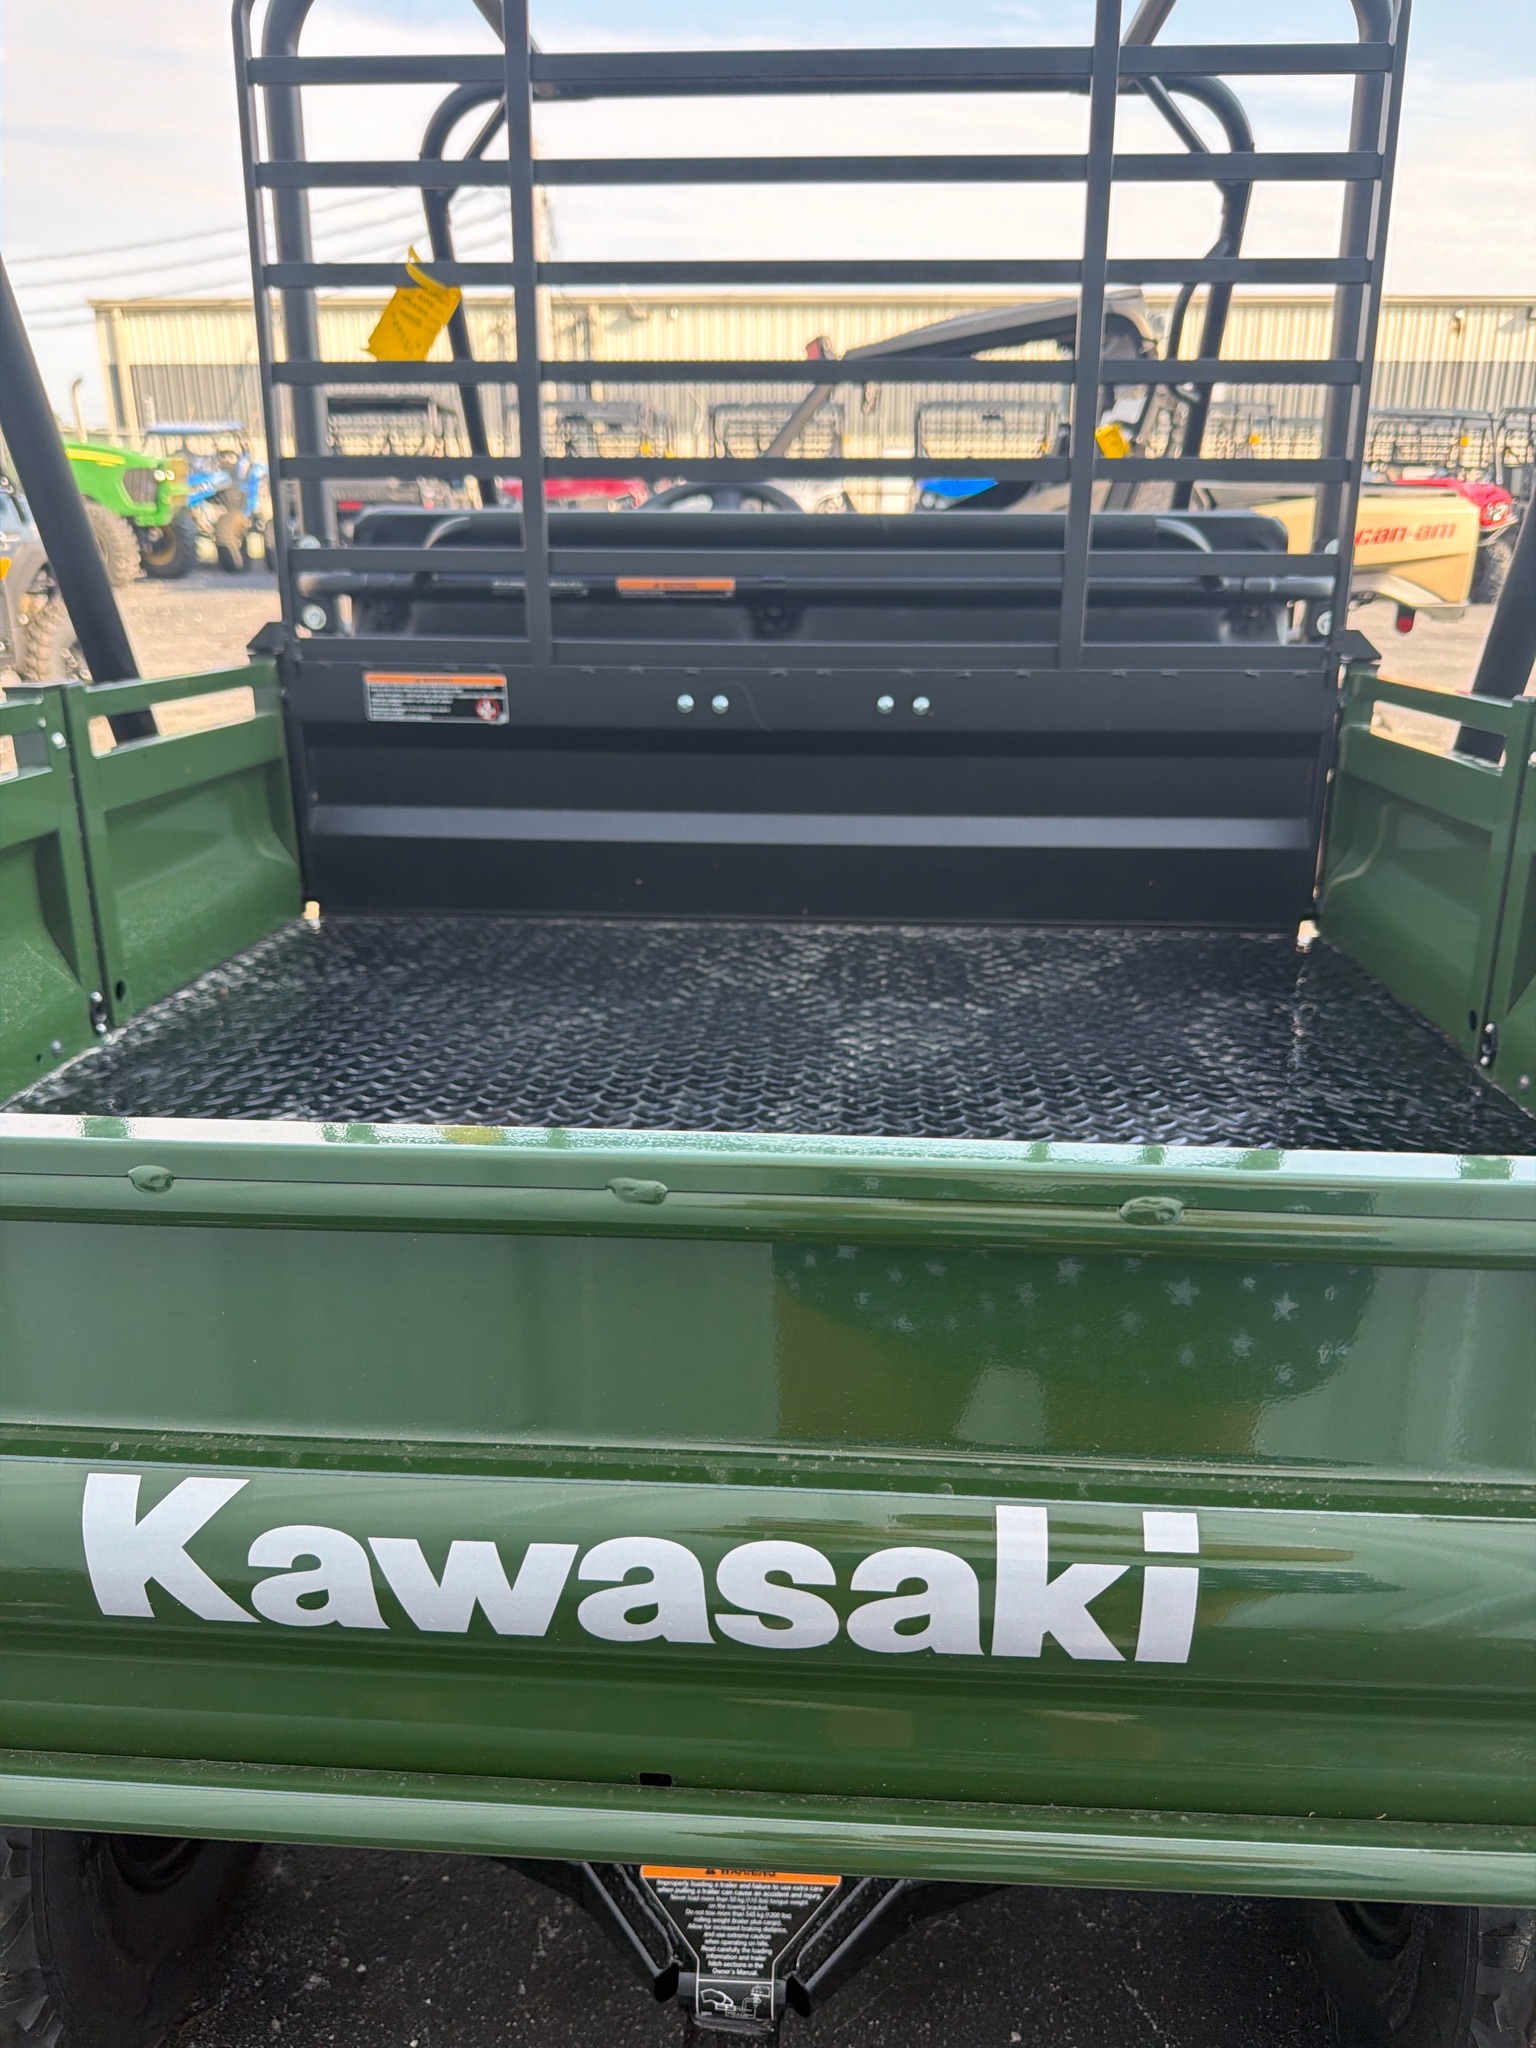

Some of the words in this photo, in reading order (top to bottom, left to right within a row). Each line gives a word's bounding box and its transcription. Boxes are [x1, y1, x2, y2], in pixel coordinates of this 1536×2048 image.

[1355, 523, 1456, 546] can-am
[80, 1473, 1200, 1665] Kawasaki
[656, 1879, 689, 1889] Improperly
[690, 1880, 713, 1890] loading
[720, 1881, 737, 1889] trailer
[752, 1882, 771, 1890] failure
[693, 1916, 711, 1924] rolling
[750, 1918, 762, 1926] plus
[741, 1925, 762, 1933] braking
[721, 1939, 747, 1947] operating
[717, 1946, 740, 1954] carefully
[752, 1947, 773, 1955] loading
[711, 1967, 735, 1975] Owner's
[736, 1968, 760, 1976] Manual.
